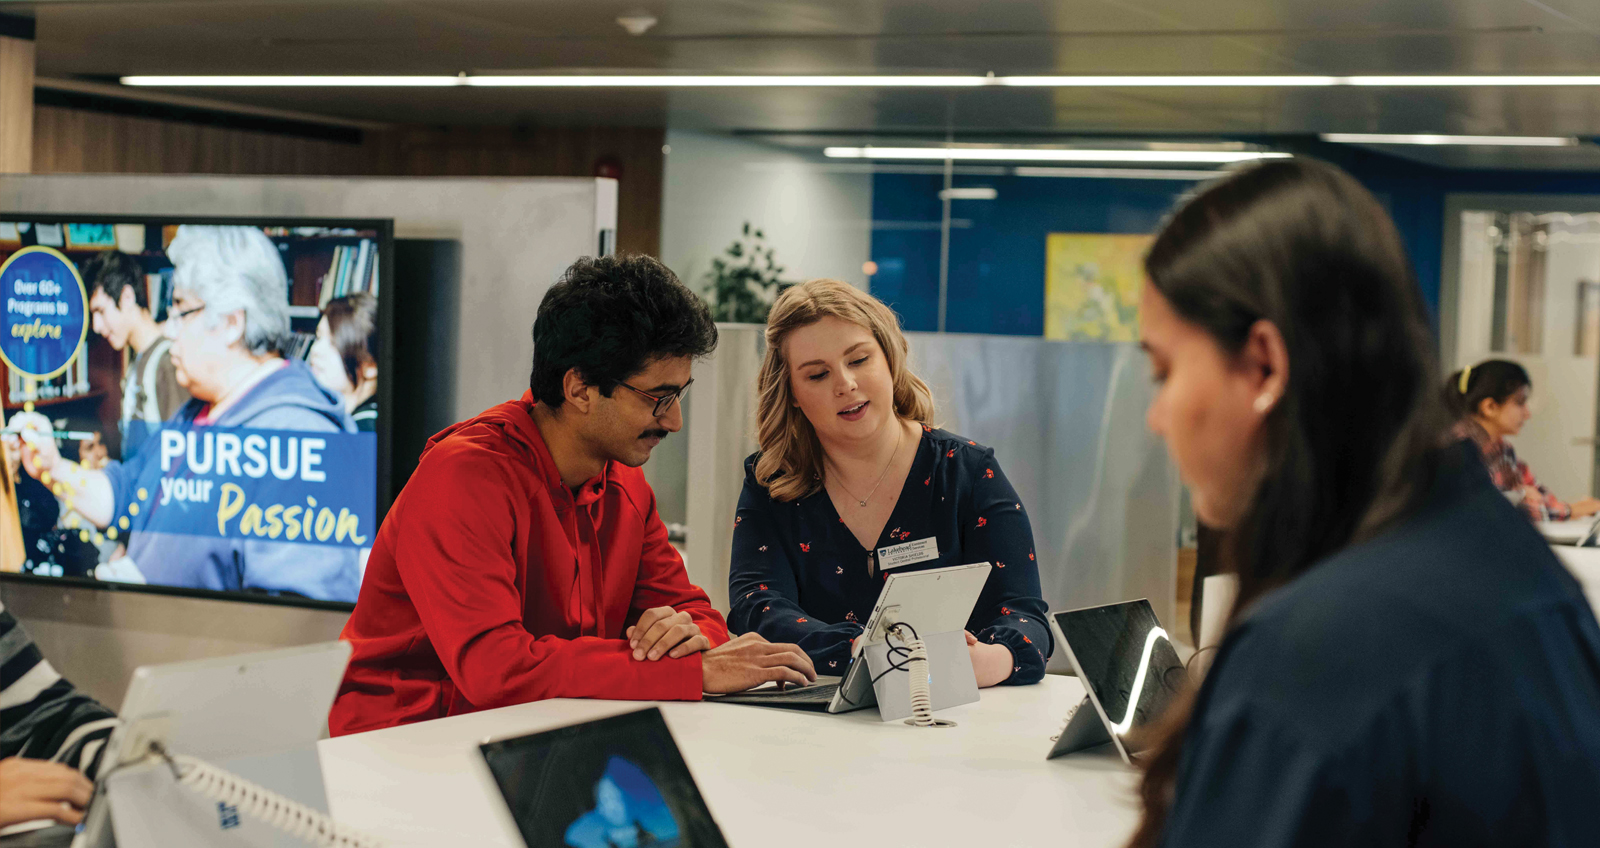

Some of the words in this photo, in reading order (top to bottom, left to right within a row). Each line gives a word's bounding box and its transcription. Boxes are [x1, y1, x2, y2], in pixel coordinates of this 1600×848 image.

[14, 279, 38, 295] Over
[39, 280, 61, 296] 60+
[7, 297, 56, 317] Programs
[56, 300, 69, 316] to
[11, 317, 62, 344] explore
[161, 429, 326, 482] PURSUE
[160, 476, 213, 506] your
[217, 482, 368, 545] Passion
